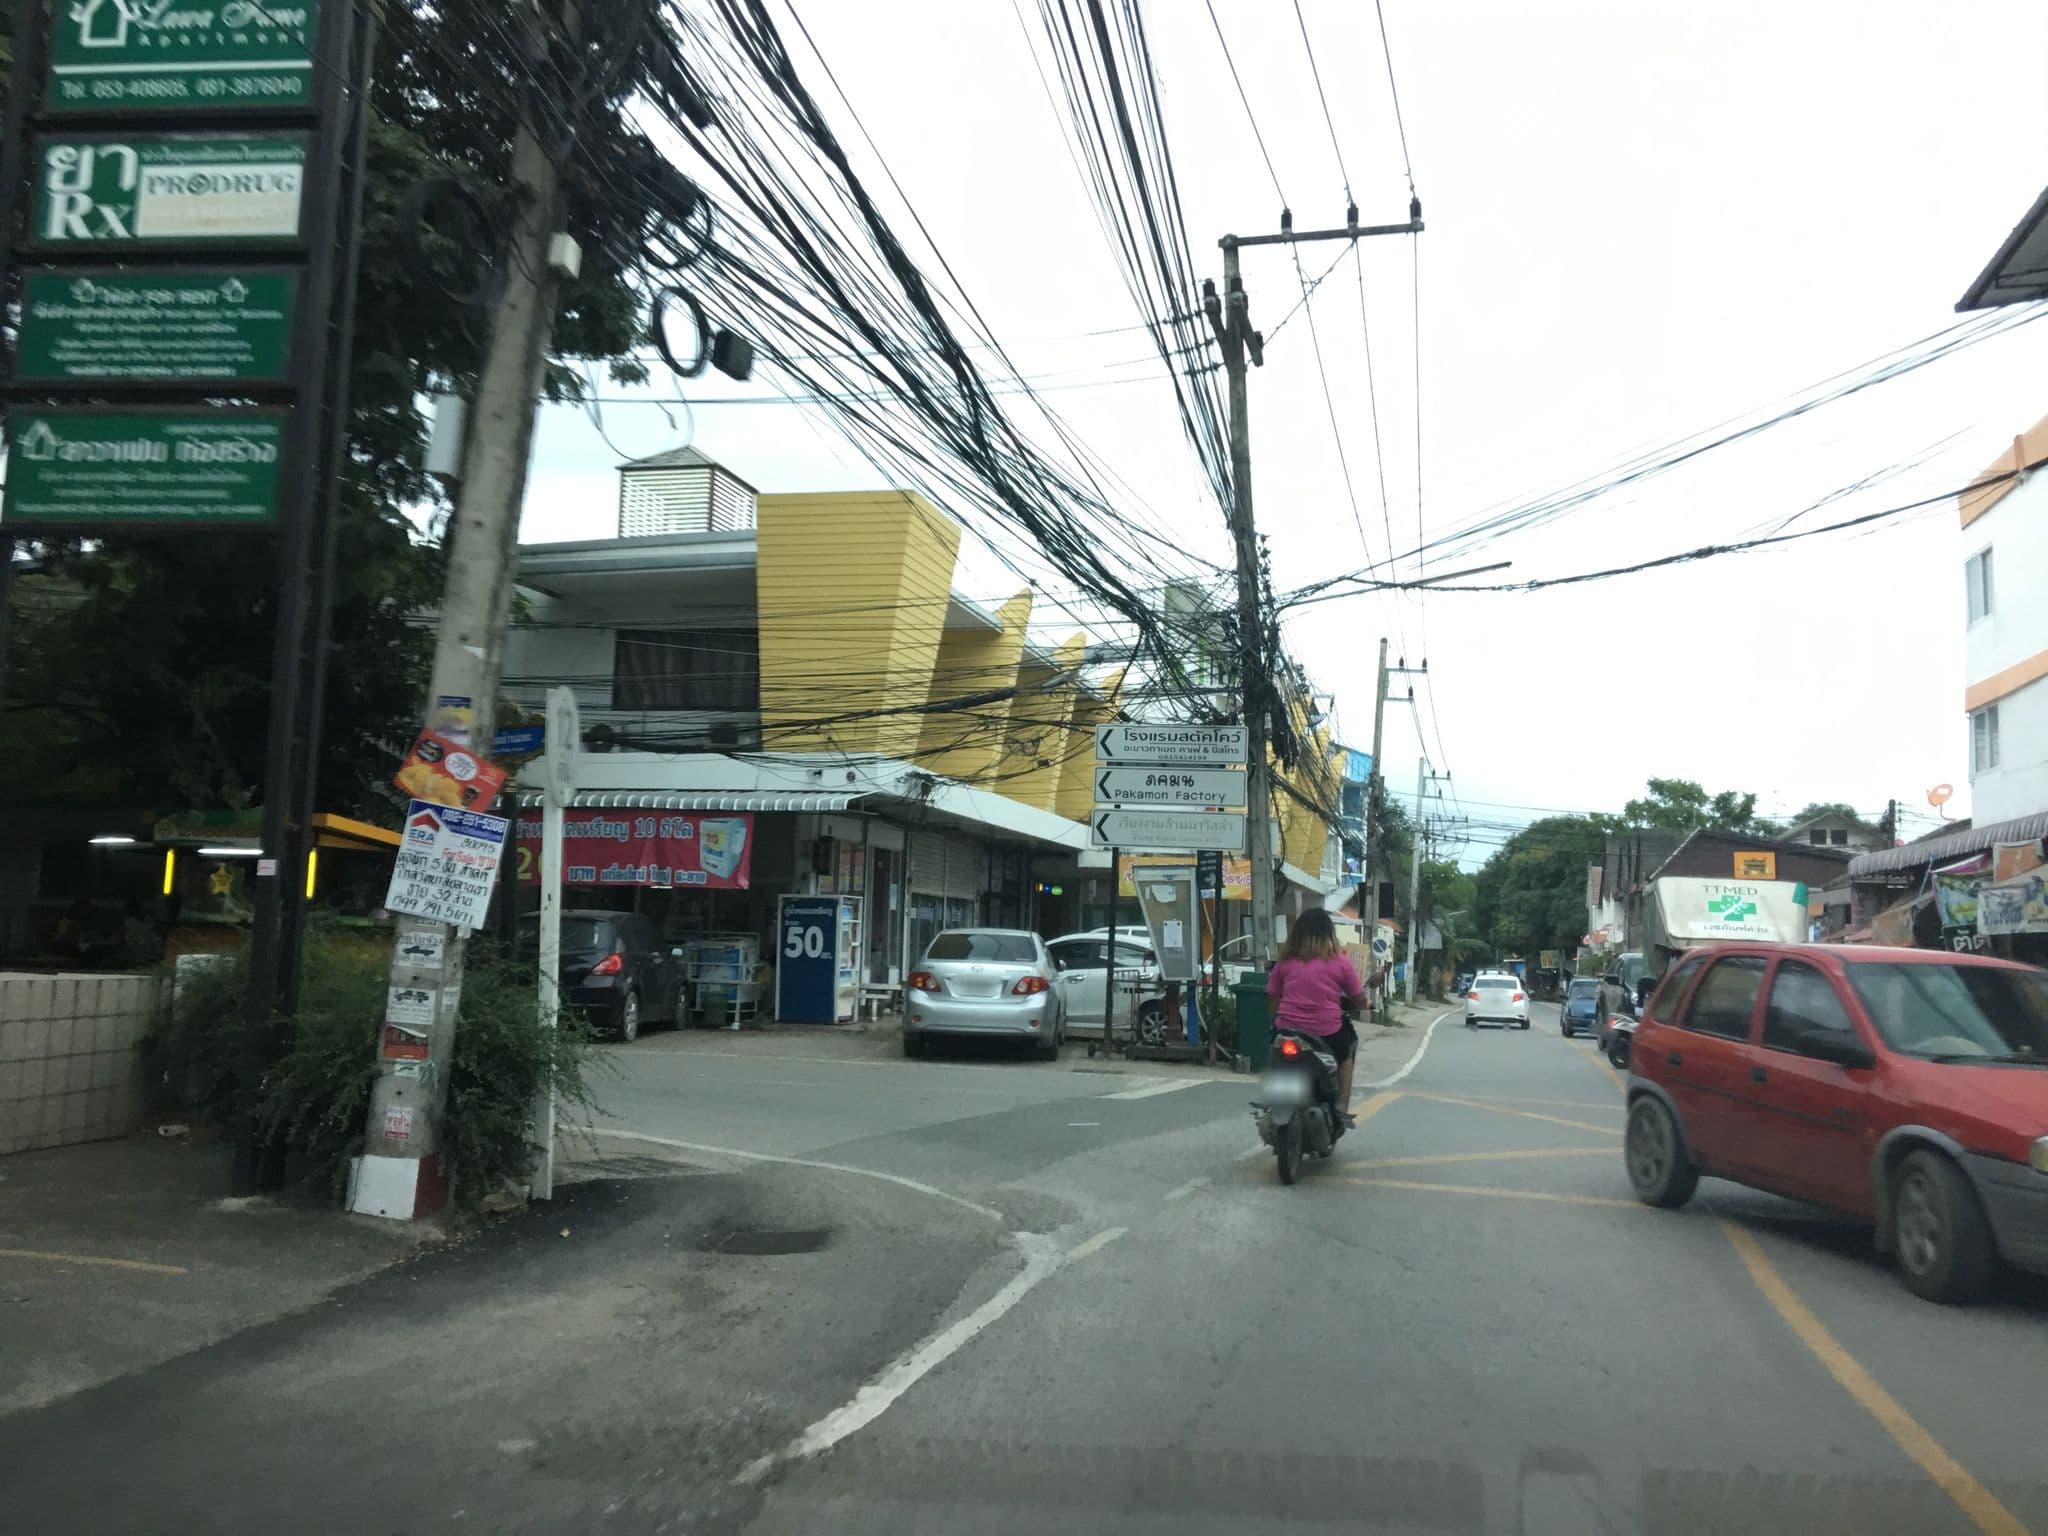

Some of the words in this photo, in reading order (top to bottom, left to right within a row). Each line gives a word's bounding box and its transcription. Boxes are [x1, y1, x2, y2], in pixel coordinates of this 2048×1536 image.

[46, 145, 138, 192] ยา
[1115, 789, 1168, 800] Pakamon
[1175, 791, 1226, 803] Factory
[409, 829, 435, 842] ERA
[634, 818, 656, 838] 10
[392, 895, 418, 910] 099
[433, 889, 450, 902] 32
[784, 925, 824, 958] 50
